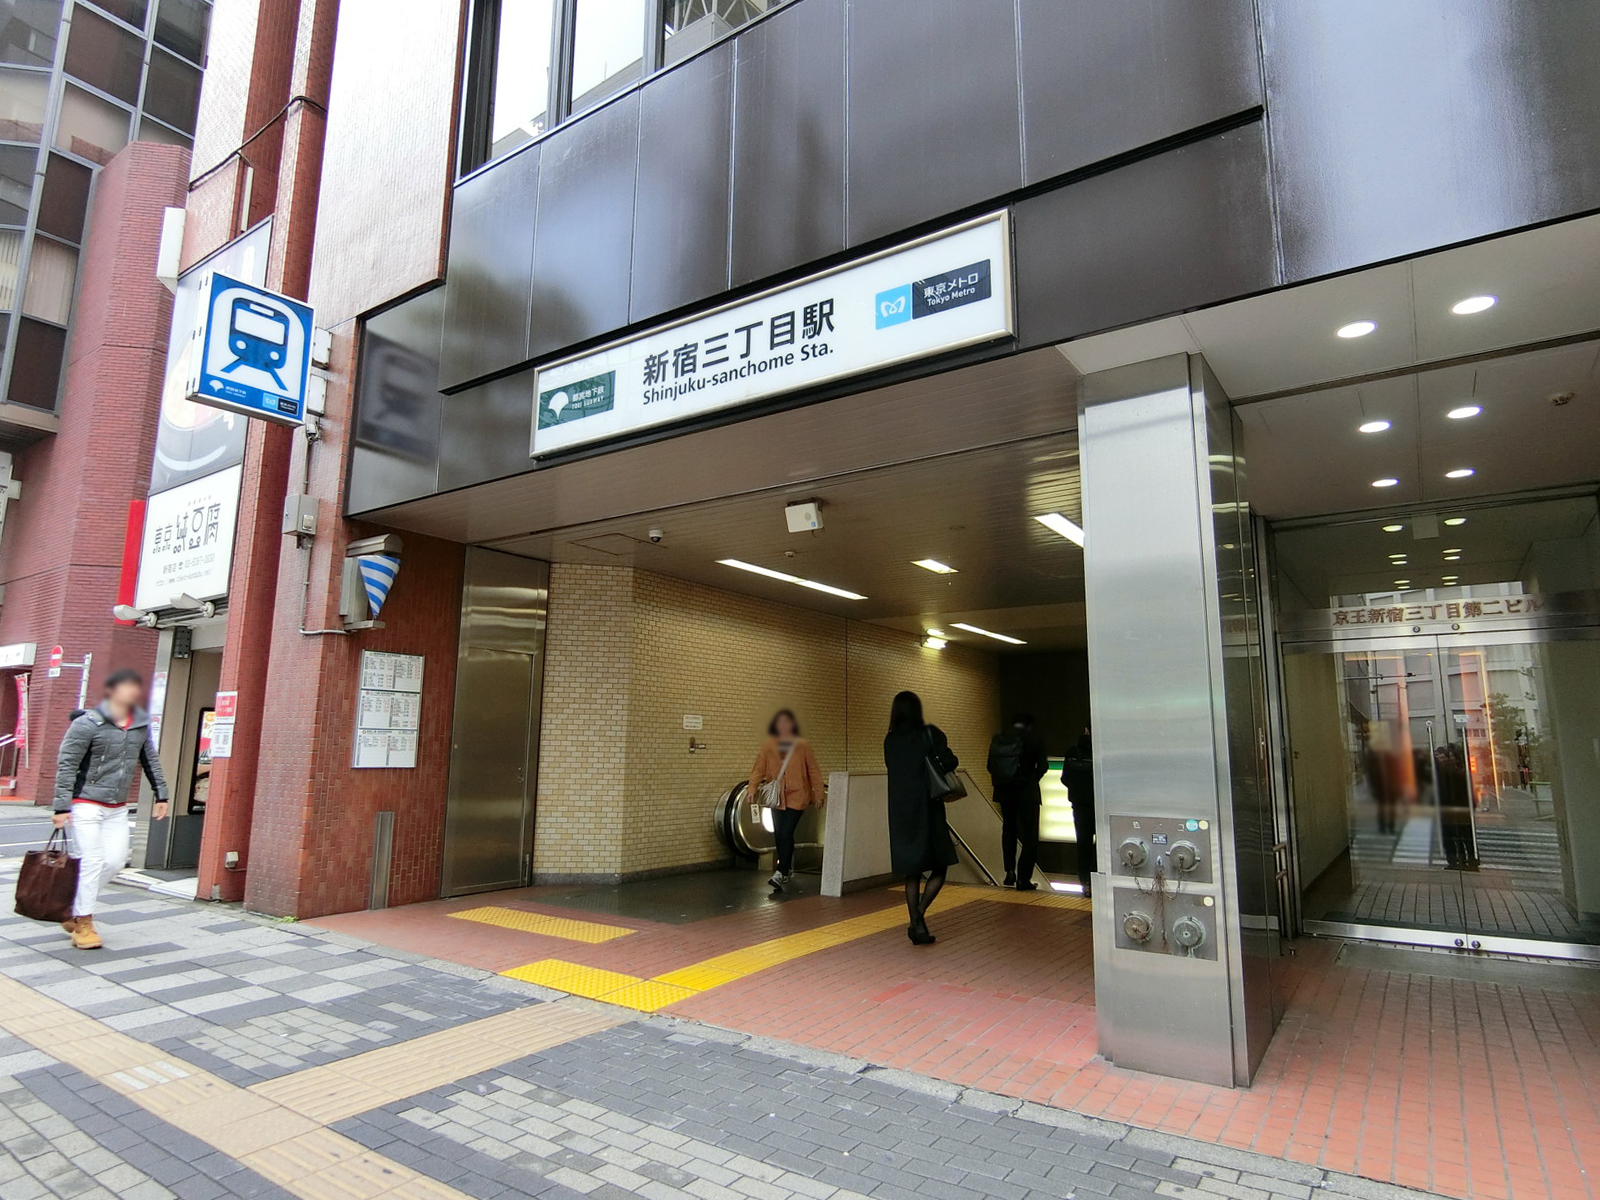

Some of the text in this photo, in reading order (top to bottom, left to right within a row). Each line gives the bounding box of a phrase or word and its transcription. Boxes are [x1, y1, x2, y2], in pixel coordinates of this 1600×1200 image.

[923, 272, 978, 299] 東京メトロ
[927, 286, 976, 307] Tokyo Metro
[643, 298, 835, 387] 新宿三丁目駅
[643, 341, 834, 405] Shinjuku-sanchome Sta.
[1332, 598, 1544, 627] 京王新宿三丁目第二ビル
